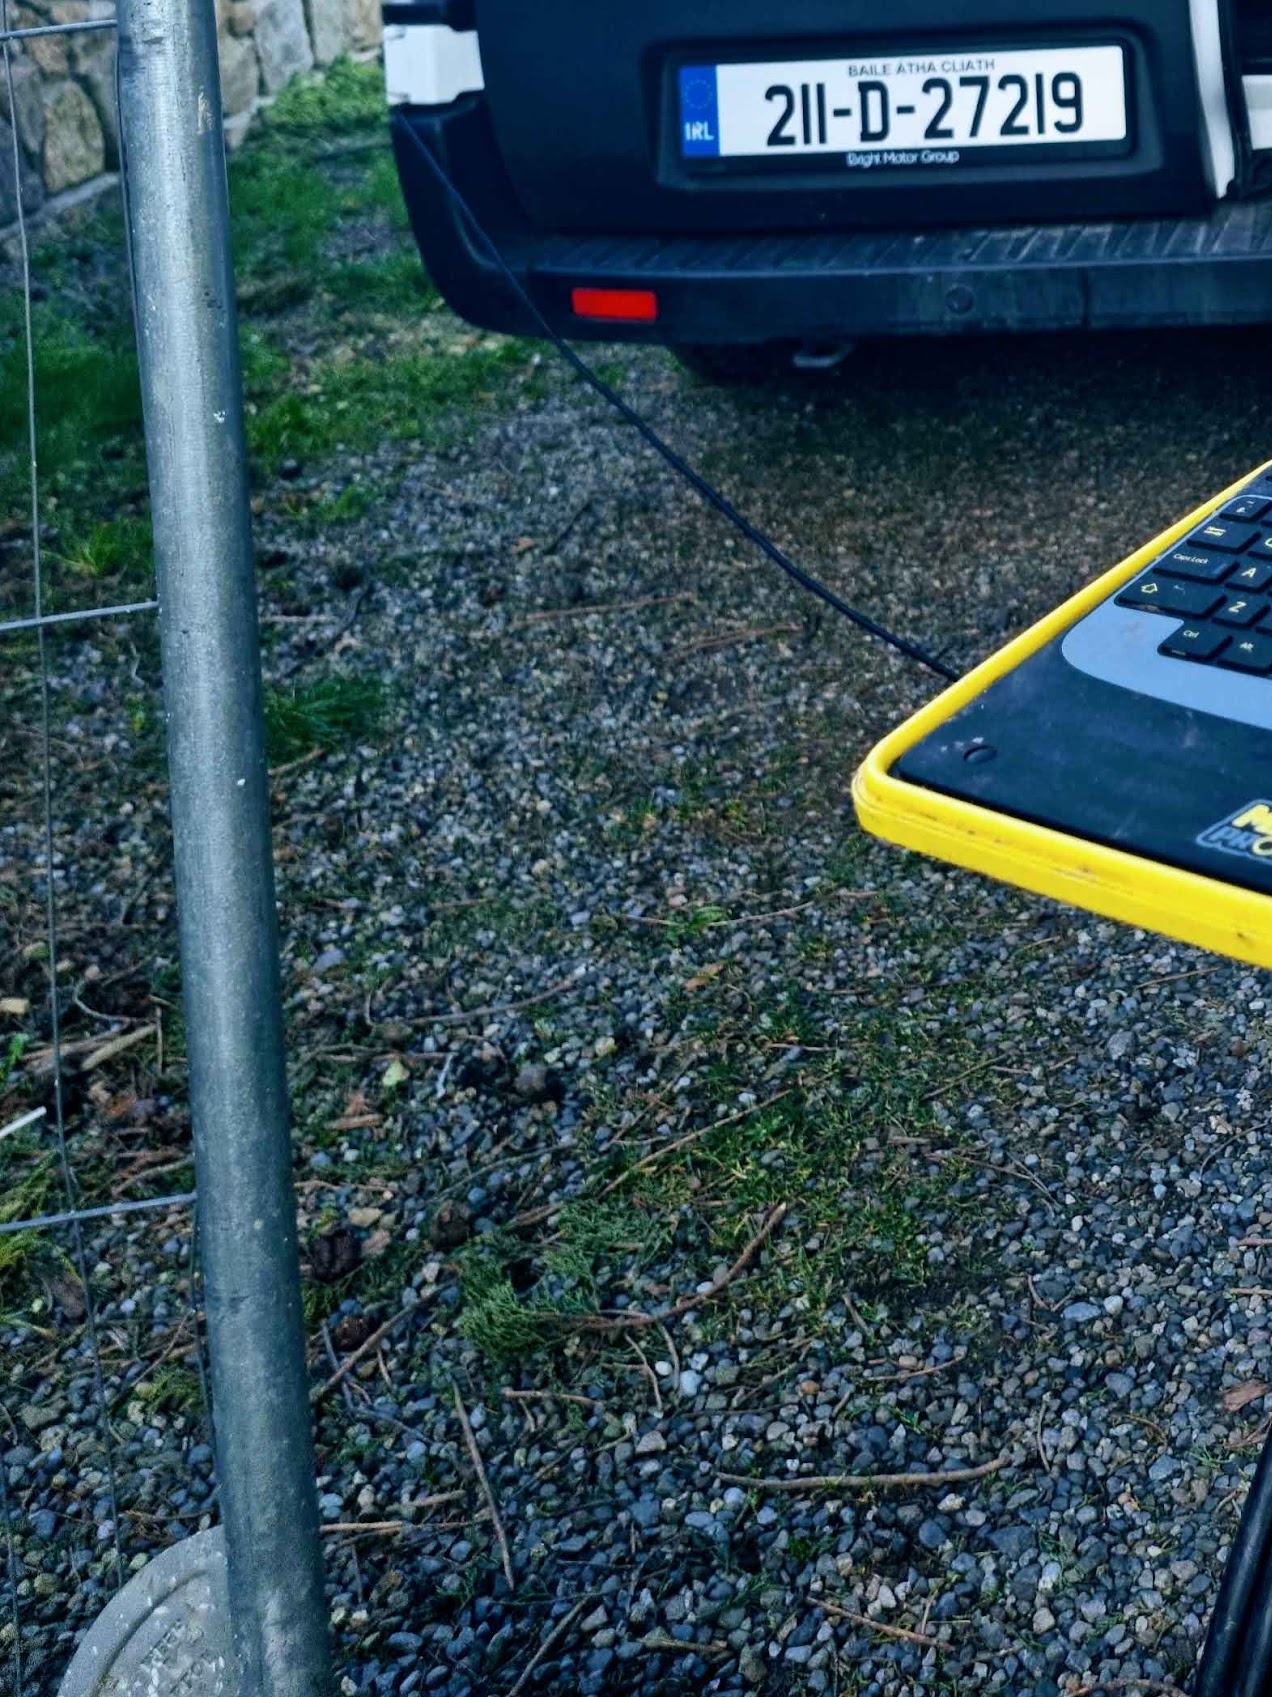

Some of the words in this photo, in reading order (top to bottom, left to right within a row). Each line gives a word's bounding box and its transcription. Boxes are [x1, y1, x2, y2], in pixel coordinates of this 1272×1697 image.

[848, 64, 891, 77] BAILE
[941, 58, 995, 72] CLIATH
[765, 71, 1084, 147] 211-D-27219
[684, 121, 714, 141] IRL
[883, 151, 918, 165] Motor
[921, 149, 960, 164] Group
[1173, 553, 1191, 563] Caps
[1191, 556, 1208, 565] Lock
[1241, 567, 1257, 578] A
[1228, 601, 1247, 613] Z
[1183, 629, 1200, 639] Ctrl
